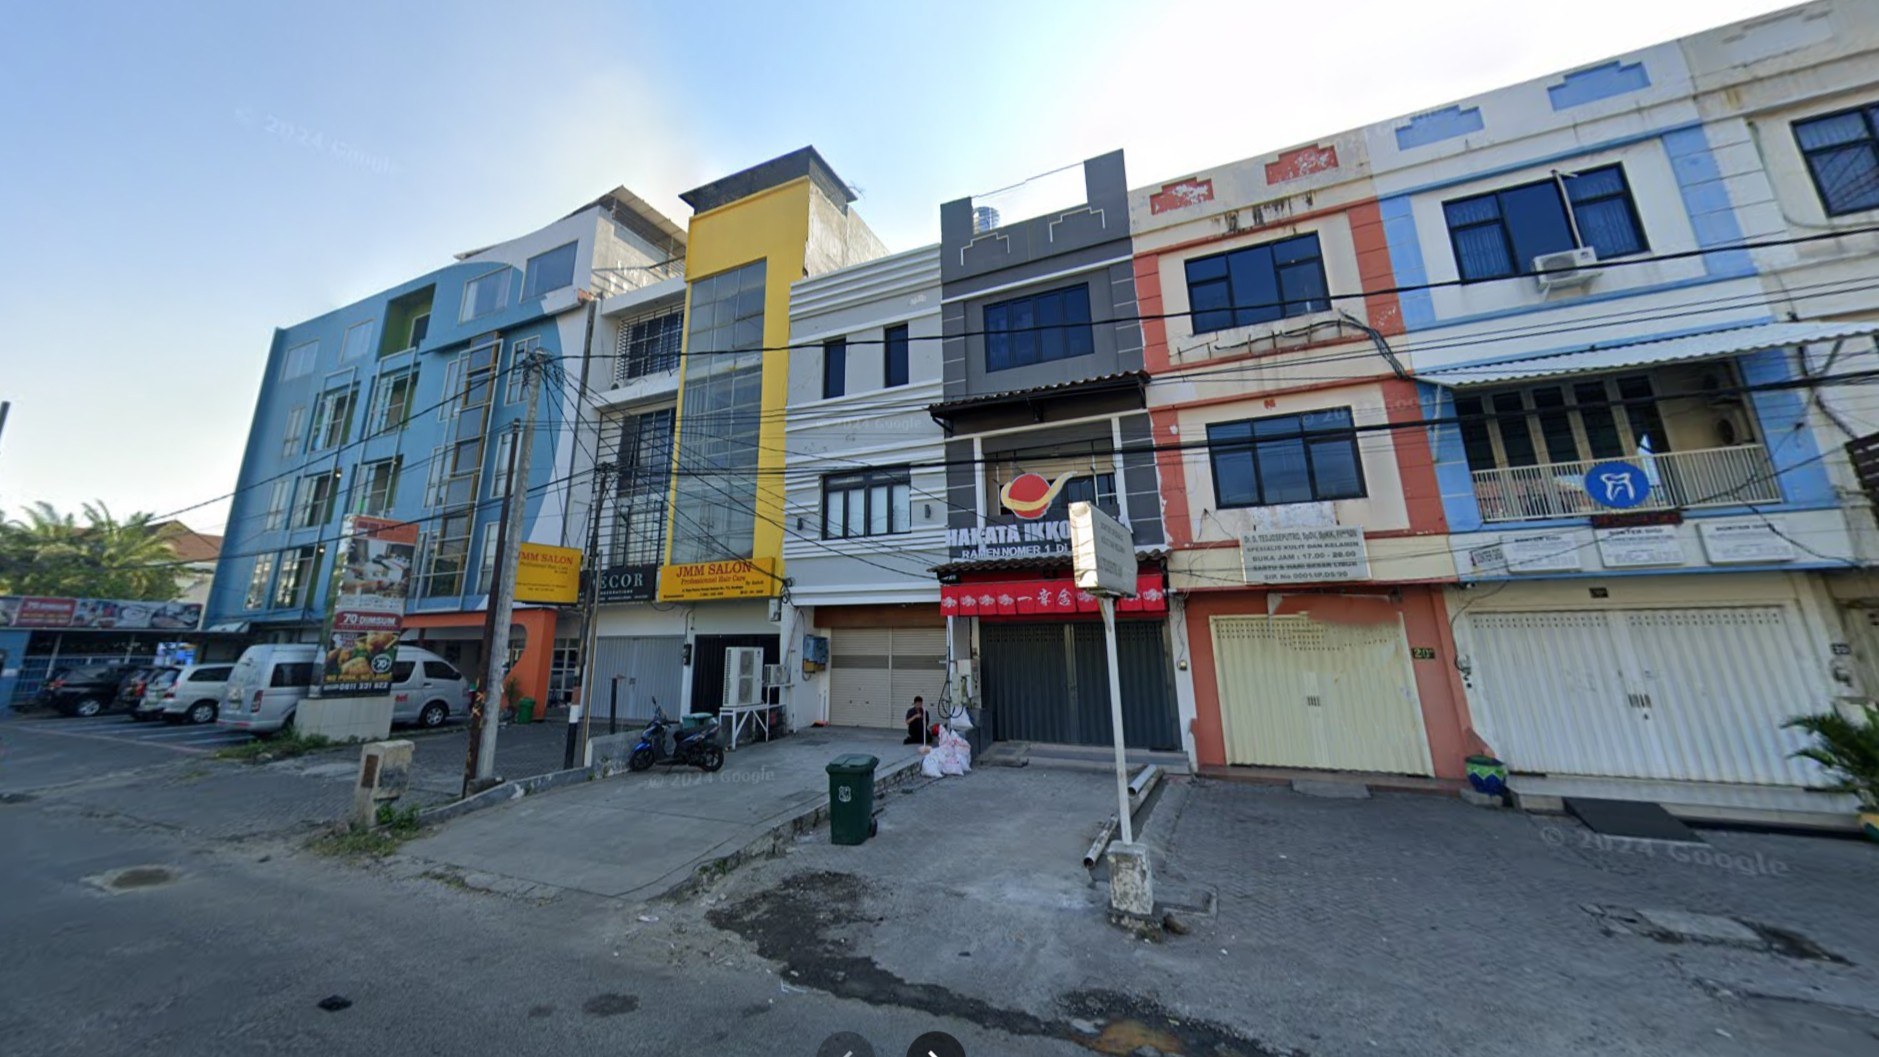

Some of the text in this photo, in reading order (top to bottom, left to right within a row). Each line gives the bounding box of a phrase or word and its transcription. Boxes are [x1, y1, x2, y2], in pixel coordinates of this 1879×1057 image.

[946, 525, 1021, 547] HAKATA
[541, 553, 574, 565] SALON
[962, 549, 1000, 559] RAMEN
[1000, 545, 1041, 556] NOMER
[676, 561, 752, 578] JMM SALON
[592, 571, 644, 590] ÉCOR
[343, 613, 396, 625] 70 DIMSUM
